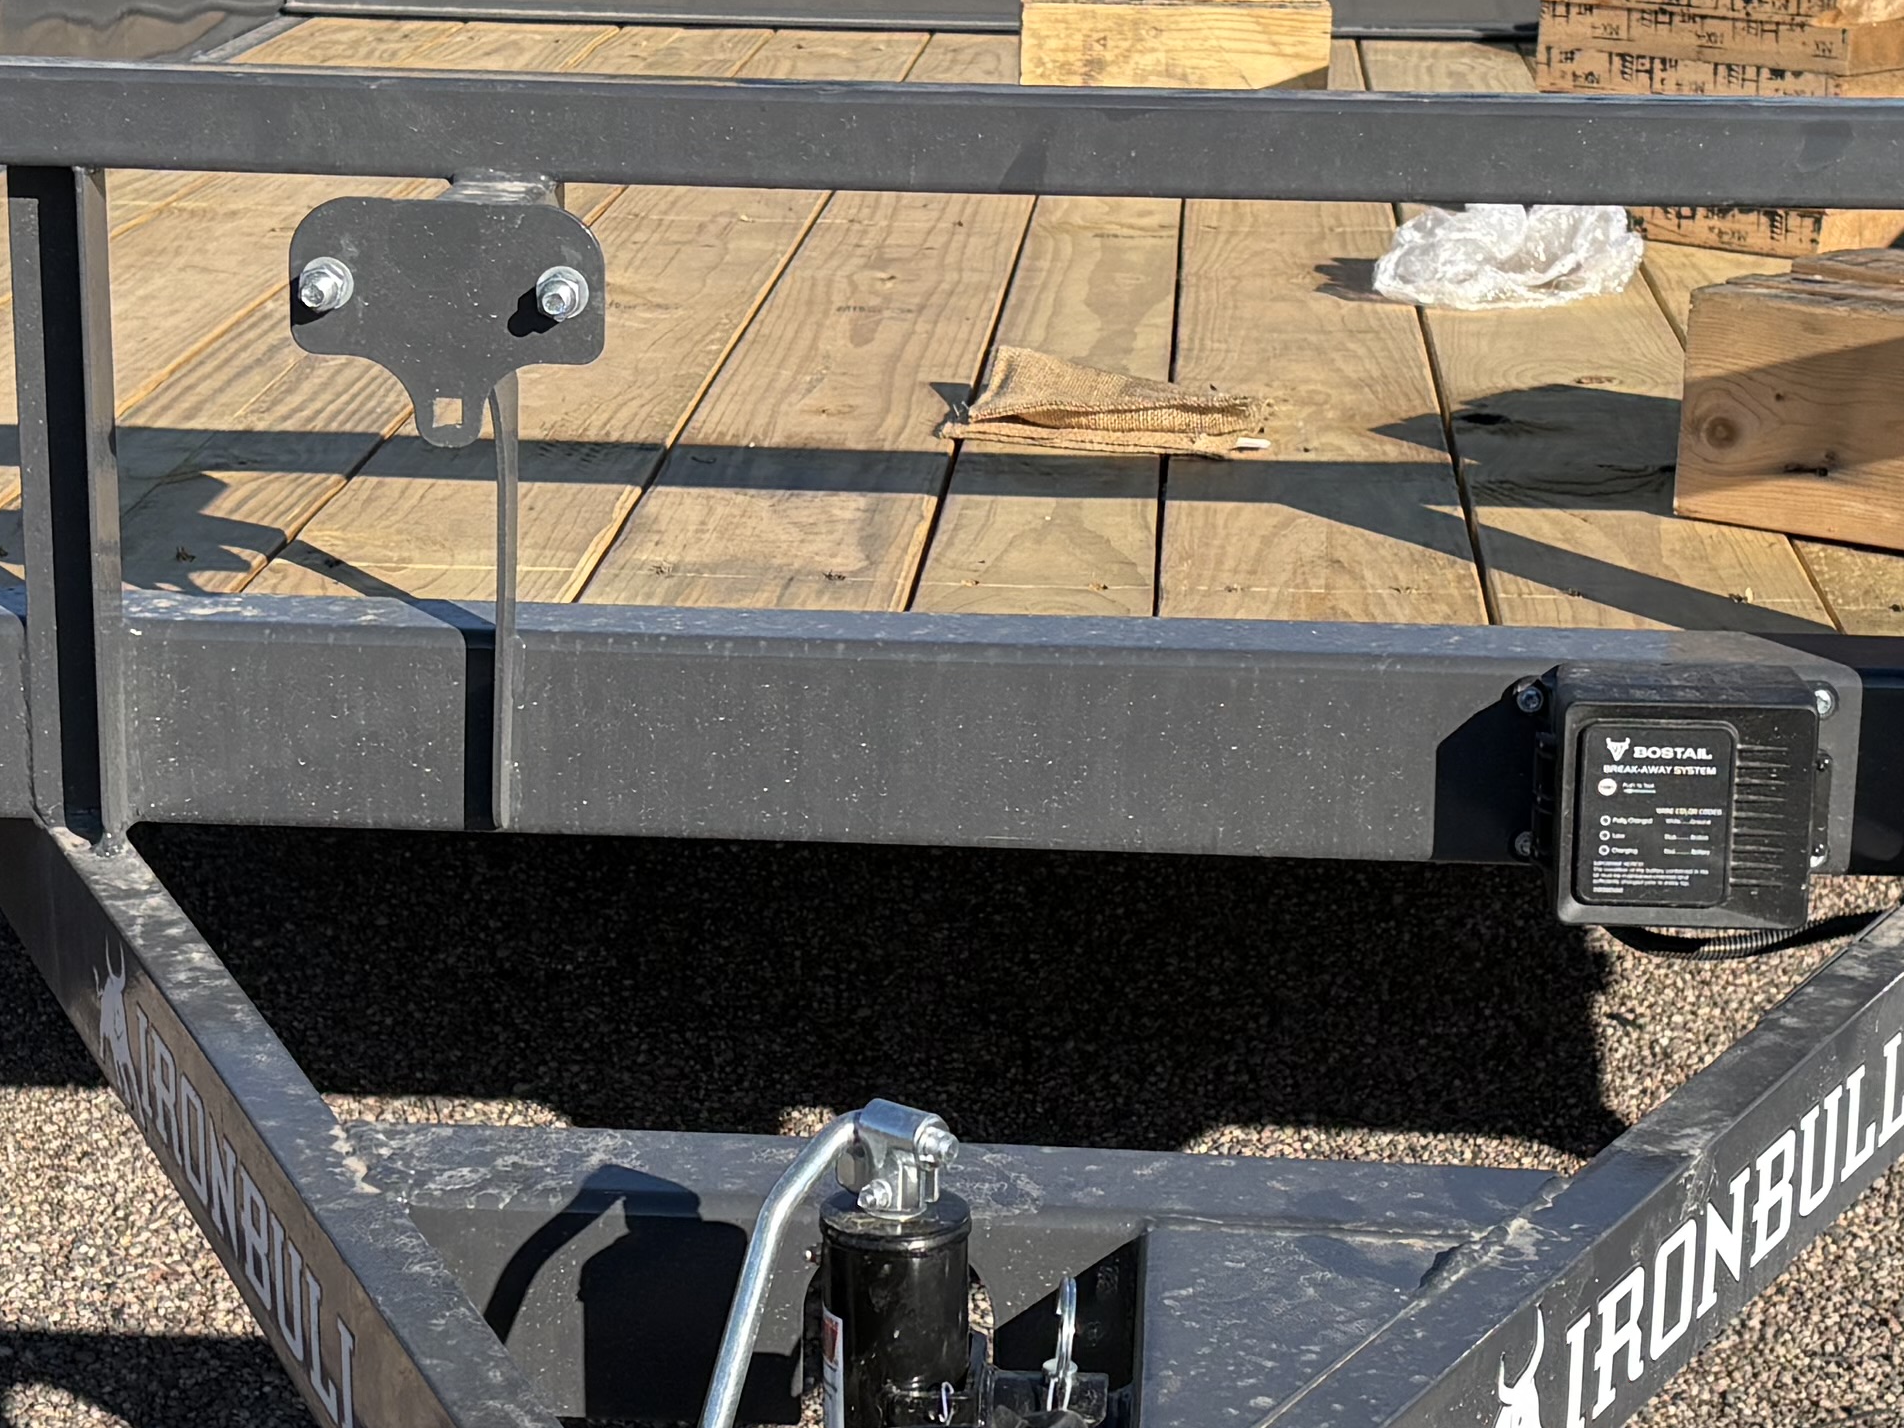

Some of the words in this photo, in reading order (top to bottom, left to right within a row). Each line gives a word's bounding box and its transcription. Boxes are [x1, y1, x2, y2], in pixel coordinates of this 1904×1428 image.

[1633, 746, 1713, 760] BOSTAIL
[1603, 764, 1672, 774] BREAK-AWAY
[1674, 766, 1717, 776] SYSTEM
